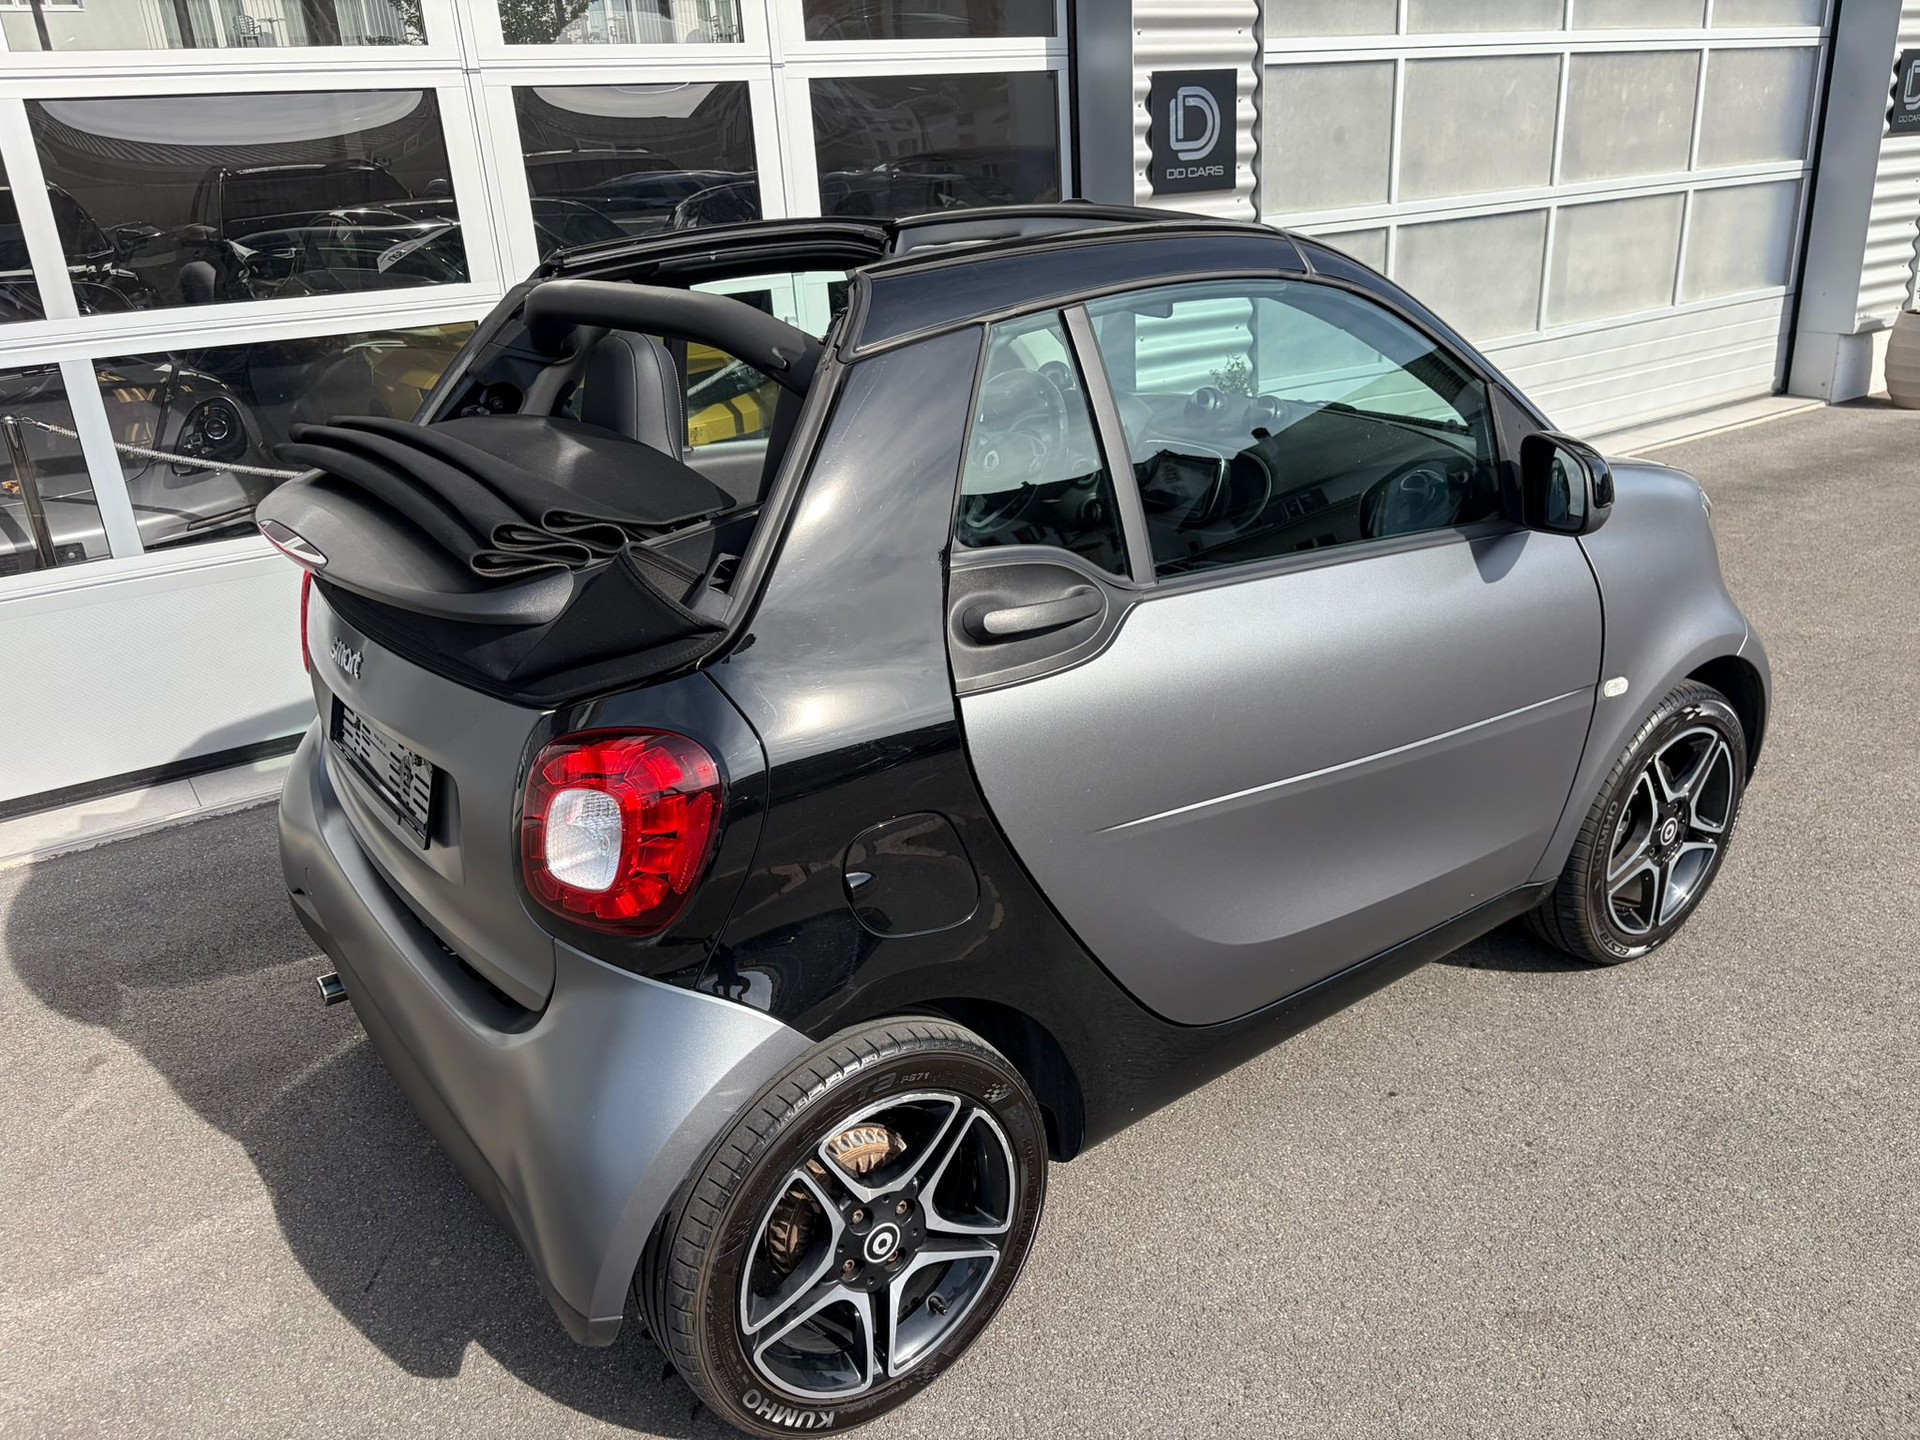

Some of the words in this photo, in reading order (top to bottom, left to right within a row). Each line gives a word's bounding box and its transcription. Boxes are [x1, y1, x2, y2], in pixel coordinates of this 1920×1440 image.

[1166, 168, 1187, 179] DD
[1187, 165, 1225, 178] CARS
[330, 636, 362, 679] smart
[1593, 800, 1619, 872] KUMHO
[900, 1071, 930, 1085] PS71
[742, 1389, 836, 1429] KUMHO
